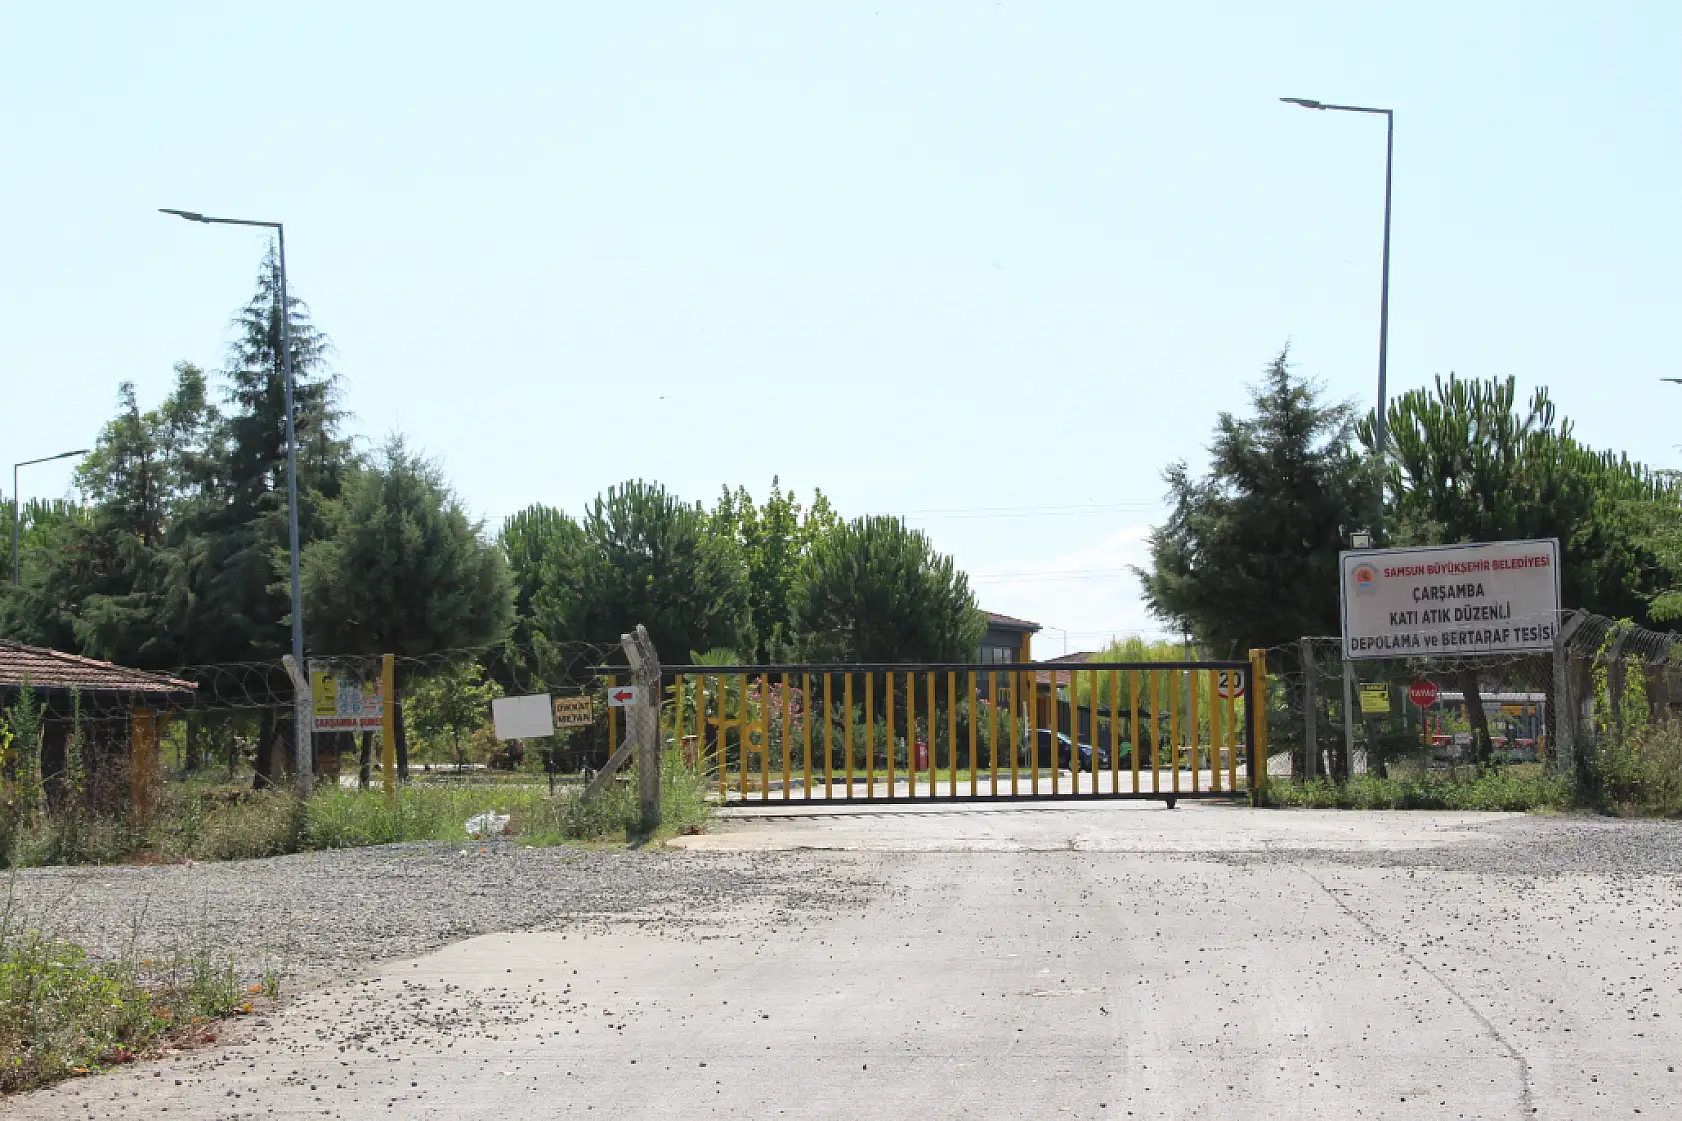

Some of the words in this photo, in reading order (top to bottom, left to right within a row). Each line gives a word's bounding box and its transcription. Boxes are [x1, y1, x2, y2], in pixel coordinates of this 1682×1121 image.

[1384, 564, 1425, 578] SAMSUN
[1427, 558, 1490, 576] BÜYÜKŞEHİR
[1492, 553, 1550, 571] BELEDİYESİ
[1413, 582, 1485, 604] ÇARŞAMBA
[1390, 611, 1418, 627] KATI
[1422, 608, 1451, 624] ATIK
[1454, 601, 1511, 622] DÜZENLİ
[1351, 633, 1420, 651] DEPOLAMA
[1424, 634, 1438, 647] ve
[1441, 628, 1510, 645] BERTARAF
